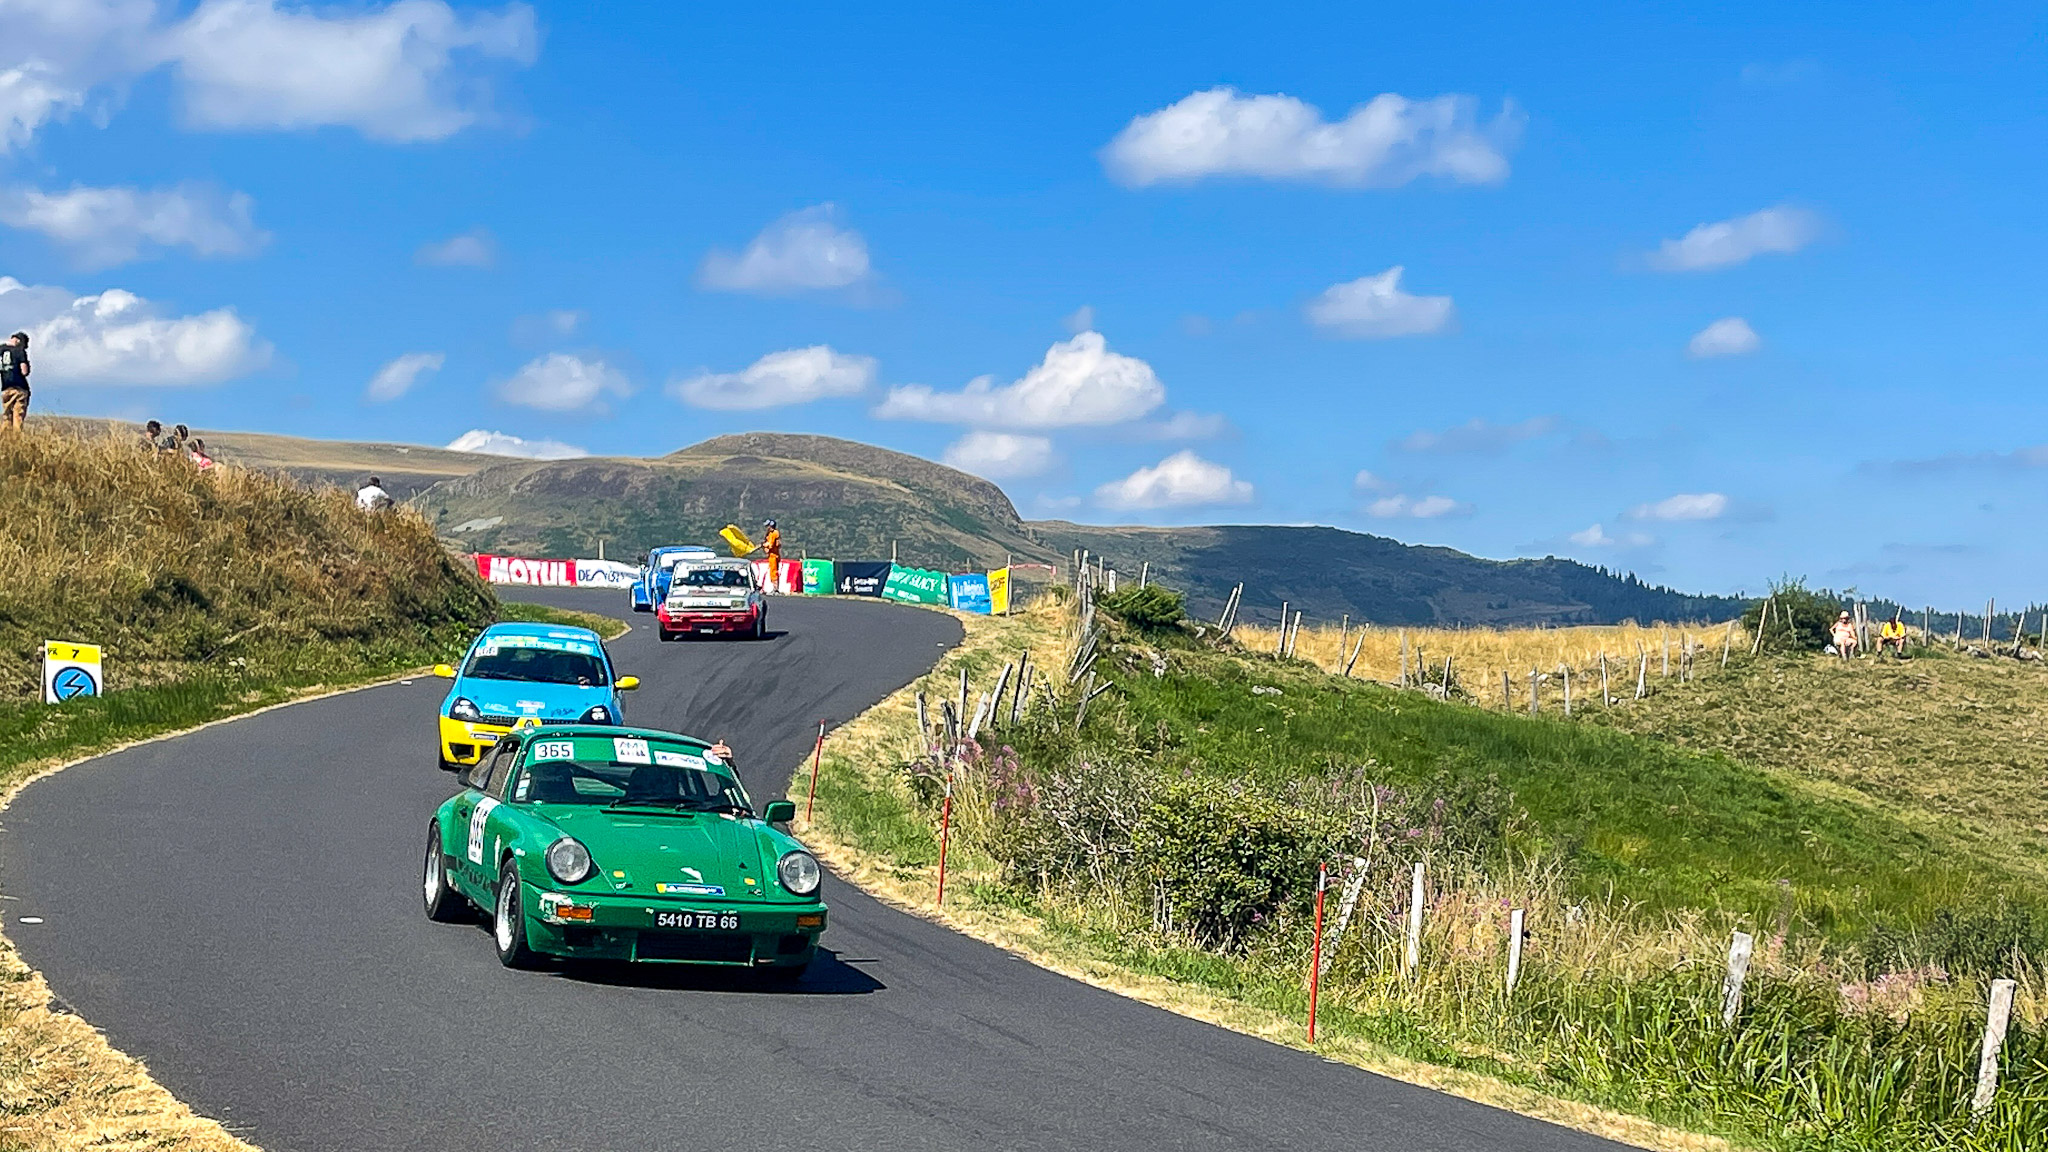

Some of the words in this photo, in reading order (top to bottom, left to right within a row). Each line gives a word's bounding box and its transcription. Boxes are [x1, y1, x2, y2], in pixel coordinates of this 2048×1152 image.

[489, 557, 572, 586] MOTUL
[72, 649, 80, 659] 7
[538, 744, 571, 758] 365
[658, 913, 693, 928] 5410
[696, 915, 716, 928] TB
[720, 916, 738, 929] 66
